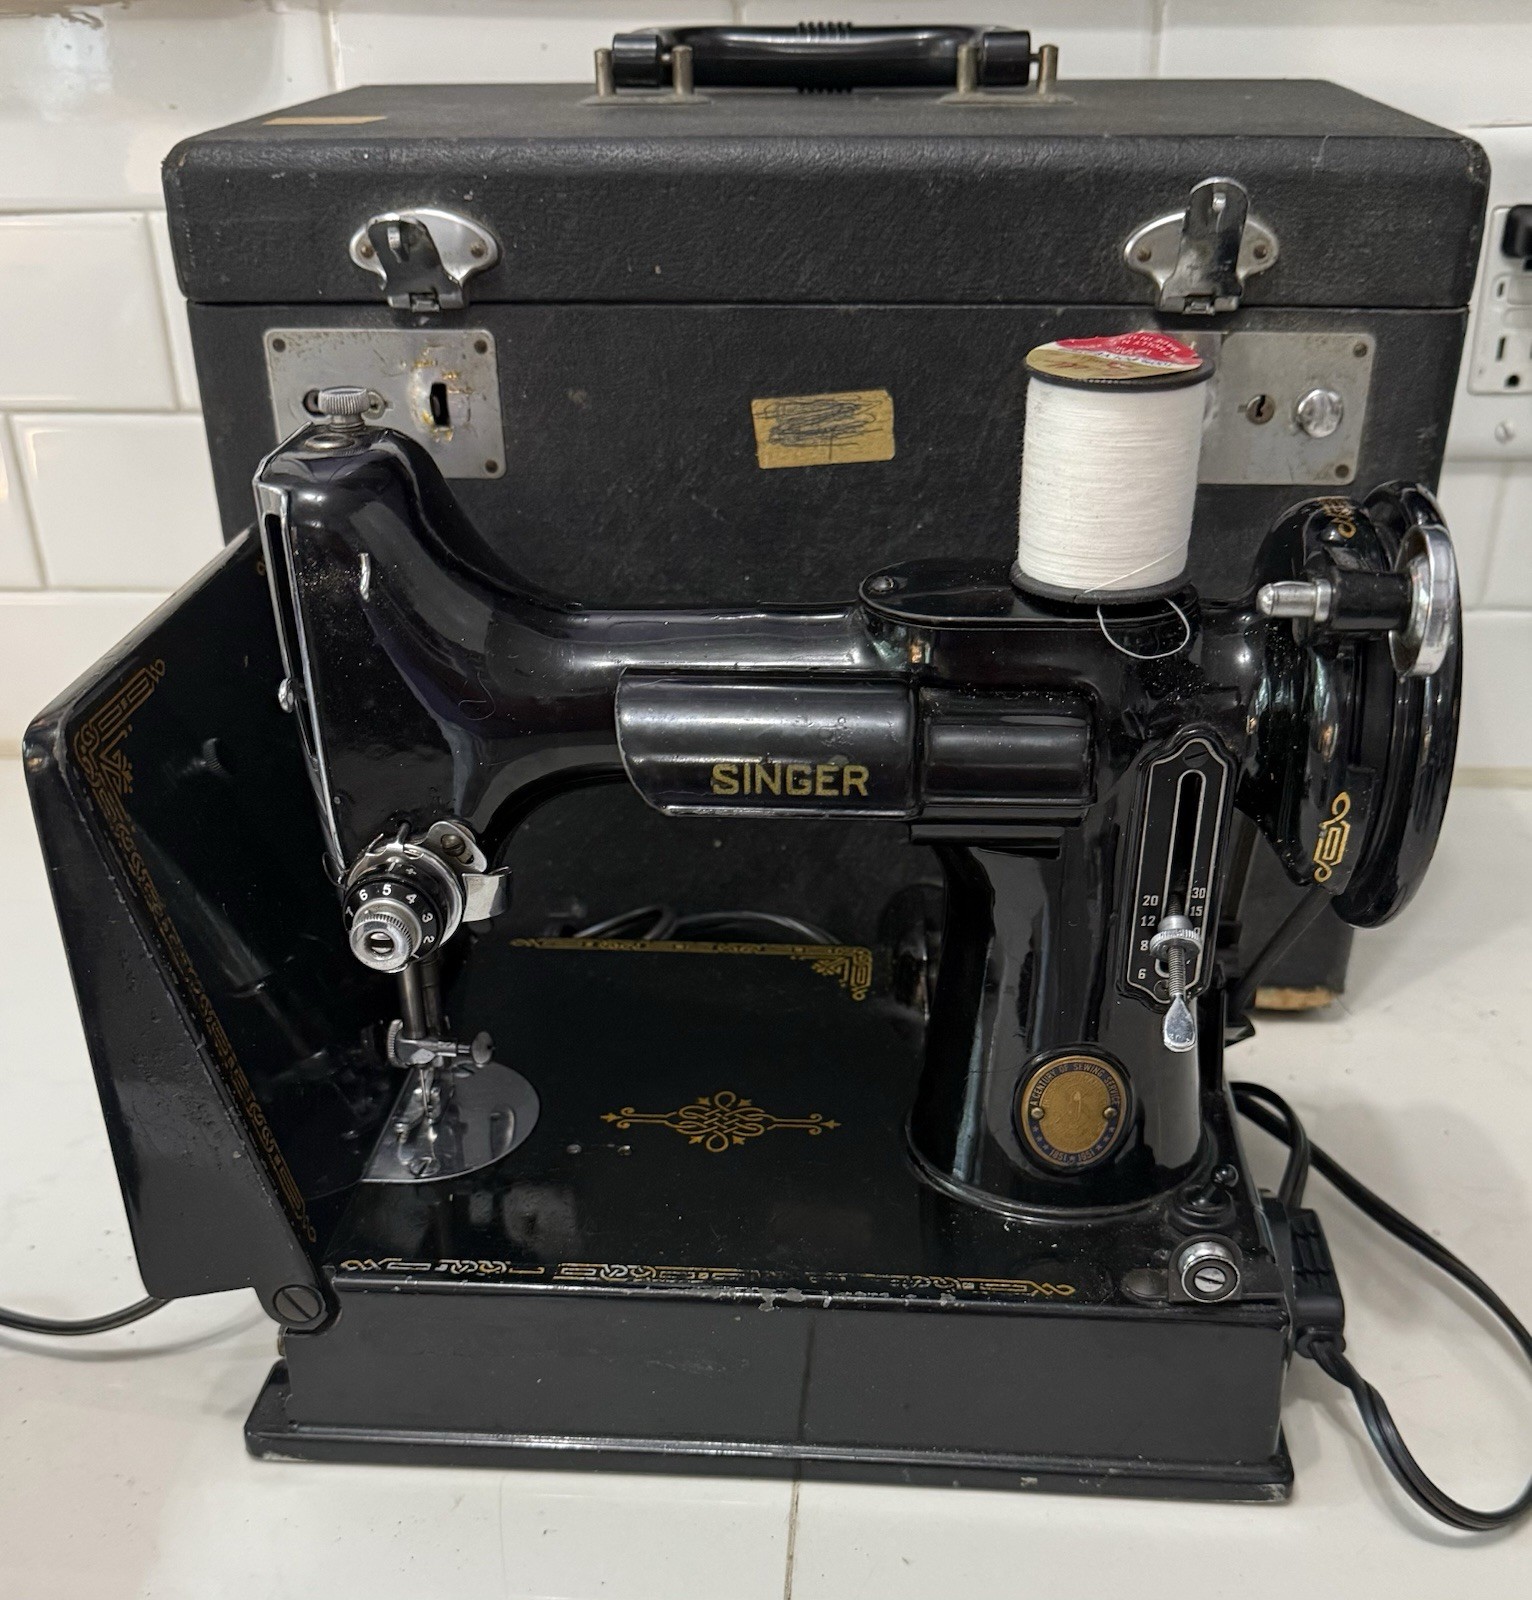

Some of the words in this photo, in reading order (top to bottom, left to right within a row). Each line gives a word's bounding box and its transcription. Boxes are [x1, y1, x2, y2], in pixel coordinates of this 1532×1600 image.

[711, 763, 869, 796] SINGER
[359, 889, 368, 901] 6
[382, 883, 392, 896] 5
[1191, 887, 1206, 899] 30
[405, 893, 417, 904] 4
[1142, 895, 1158, 907] 20
[422, 912, 434, 923] 3
[1189, 906, 1203, 917] 15
[1140, 915, 1156, 927] 12
[423, 935, 435, 944] 2
[1140, 940, 1149, 951] 8
[1138, 968, 1147, 979] 6
[1032, 1069, 1058, 1100] CENTURY
[1059, 1064, 1069, 1074] OF
[1073, 1063, 1106, 1077] SEWING
[1104, 1077, 1120, 1107] SERVICE
[1049, 1150, 1067, 1162] 1851
[1077, 1150, 1095, 1162] 1951
